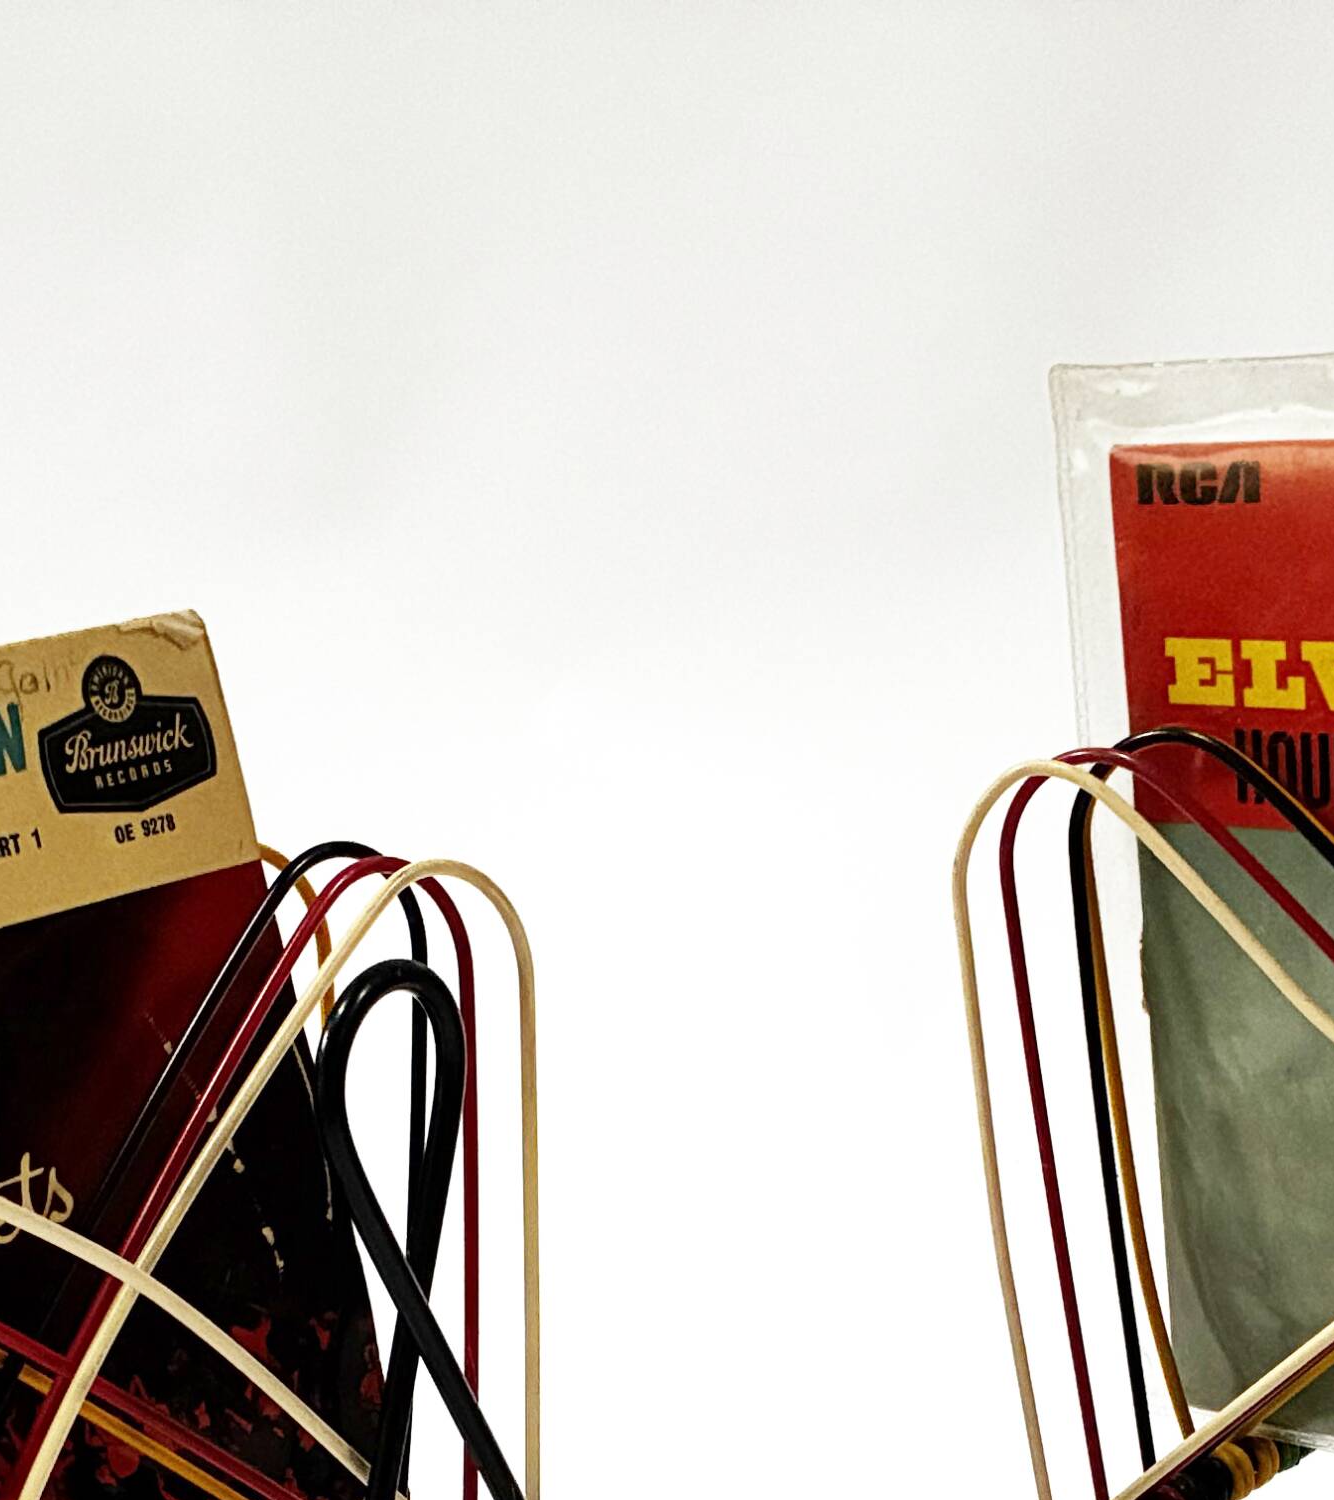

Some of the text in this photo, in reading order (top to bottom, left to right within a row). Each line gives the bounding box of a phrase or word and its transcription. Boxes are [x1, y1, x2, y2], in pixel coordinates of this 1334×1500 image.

[1135, 461, 1261, 506] RCA
[64, 711, 195, 774] Brunswick
[94, 758, 174, 790] RECORDS
[29, 827, 43, 850] 1
[114, 812, 176, 845] OE 9278
